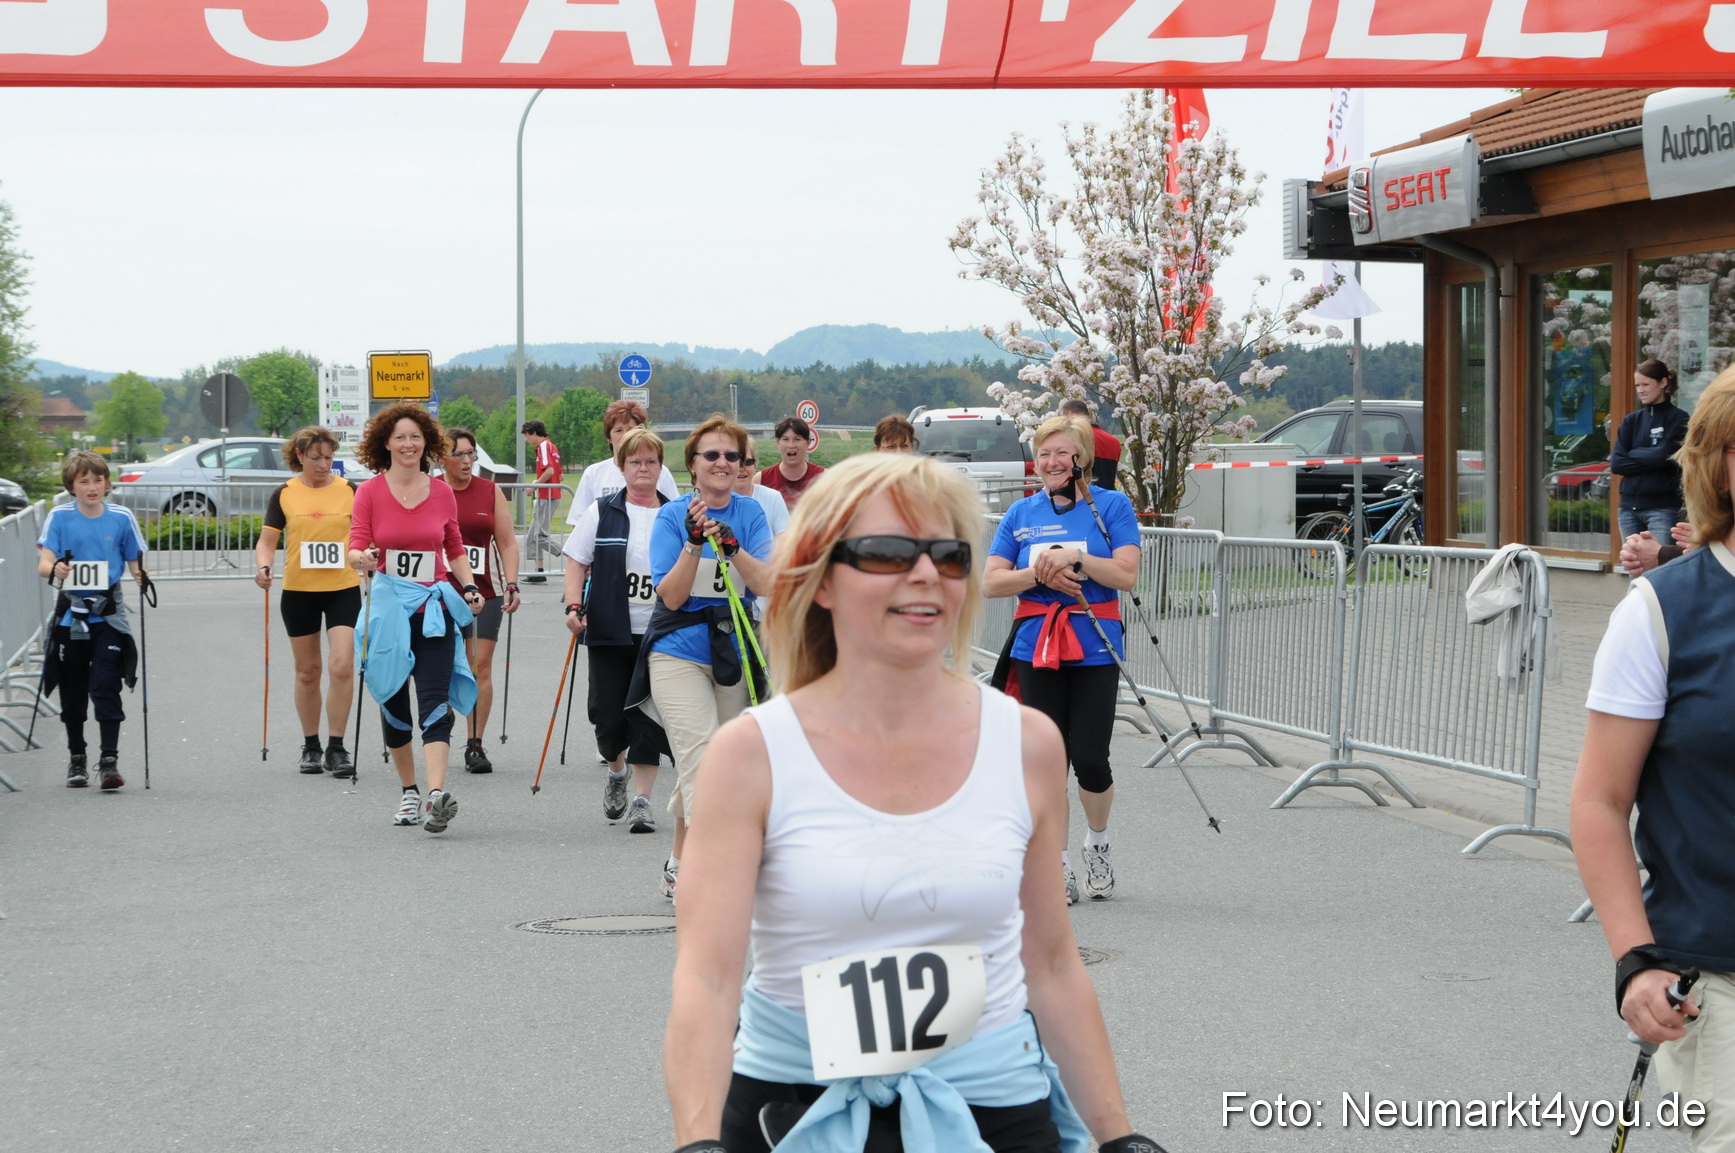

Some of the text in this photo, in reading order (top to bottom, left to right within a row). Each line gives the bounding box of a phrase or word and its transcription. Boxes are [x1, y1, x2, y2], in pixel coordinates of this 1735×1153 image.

[1383, 167, 1452, 211] SEAT
[376, 370, 425, 381] Neumarkt
[802, 407, 814, 418] 60
[307, 542, 339, 564] 108
[397, 553, 424, 577] 97
[463, 546, 480, 570] 9
[72, 563, 100, 586] 101
[626, 572, 653, 600] 85
[713, 562, 730, 593] 5
[838, 952, 950, 1055] 112
